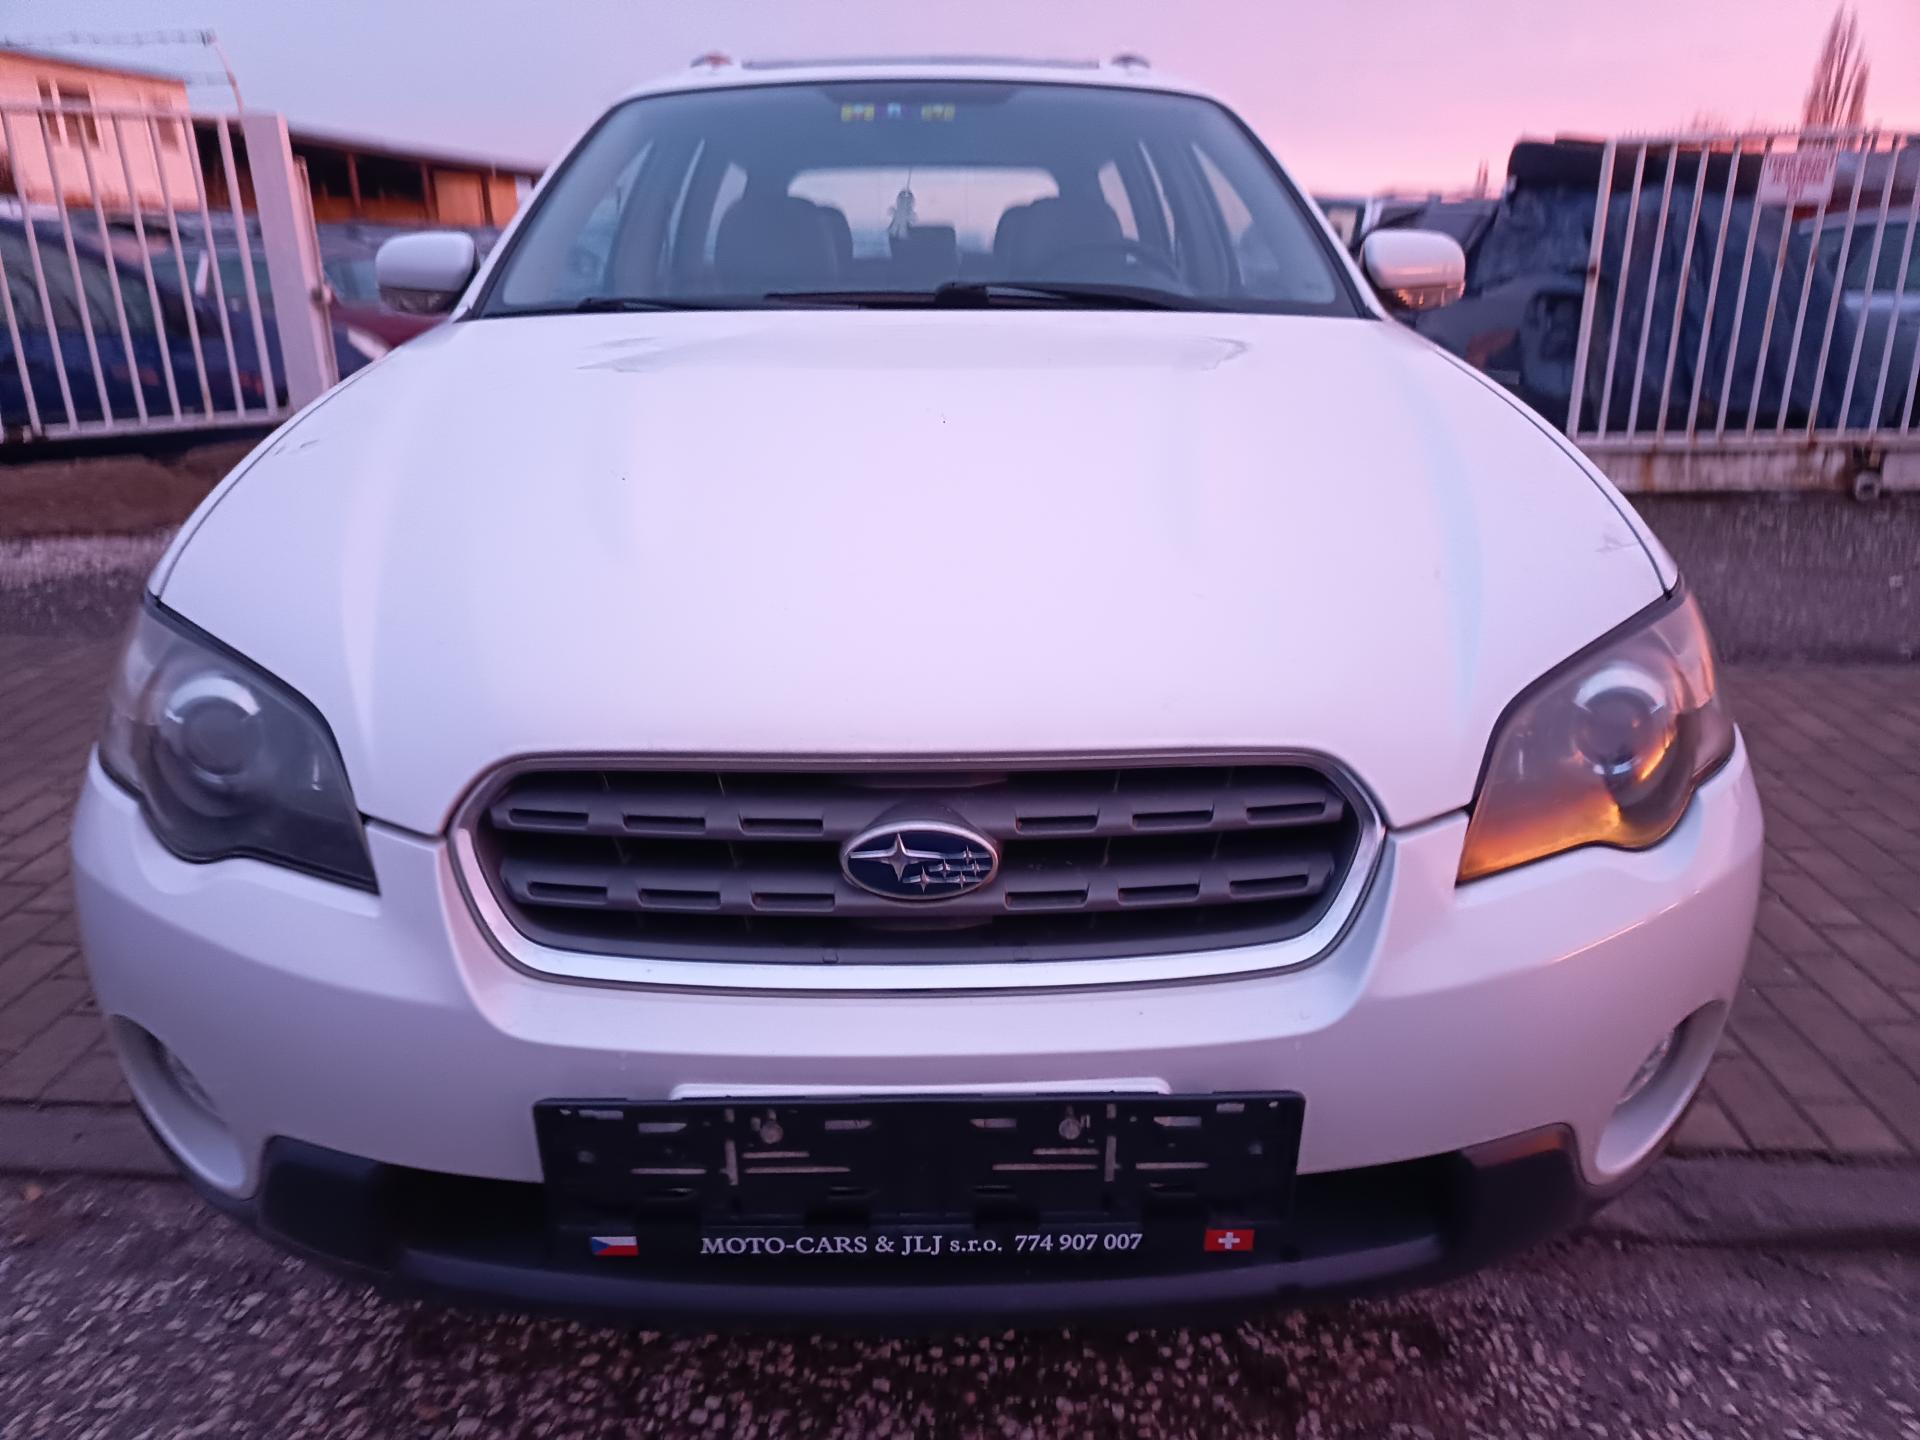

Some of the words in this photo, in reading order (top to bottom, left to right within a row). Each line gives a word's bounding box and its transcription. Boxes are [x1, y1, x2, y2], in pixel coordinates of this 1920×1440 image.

[700, 1236, 868, 1254] MOTO-CARS
[874, 1235, 895, 1253] &
[901, 1235, 943, 1256] JLJ
[949, 1239, 1003, 1252] s.r.o.
[1014, 1234, 1054, 1252] 774
[1058, 1233, 1099, 1251] 907
[1103, 1232, 1143, 1251] 007
